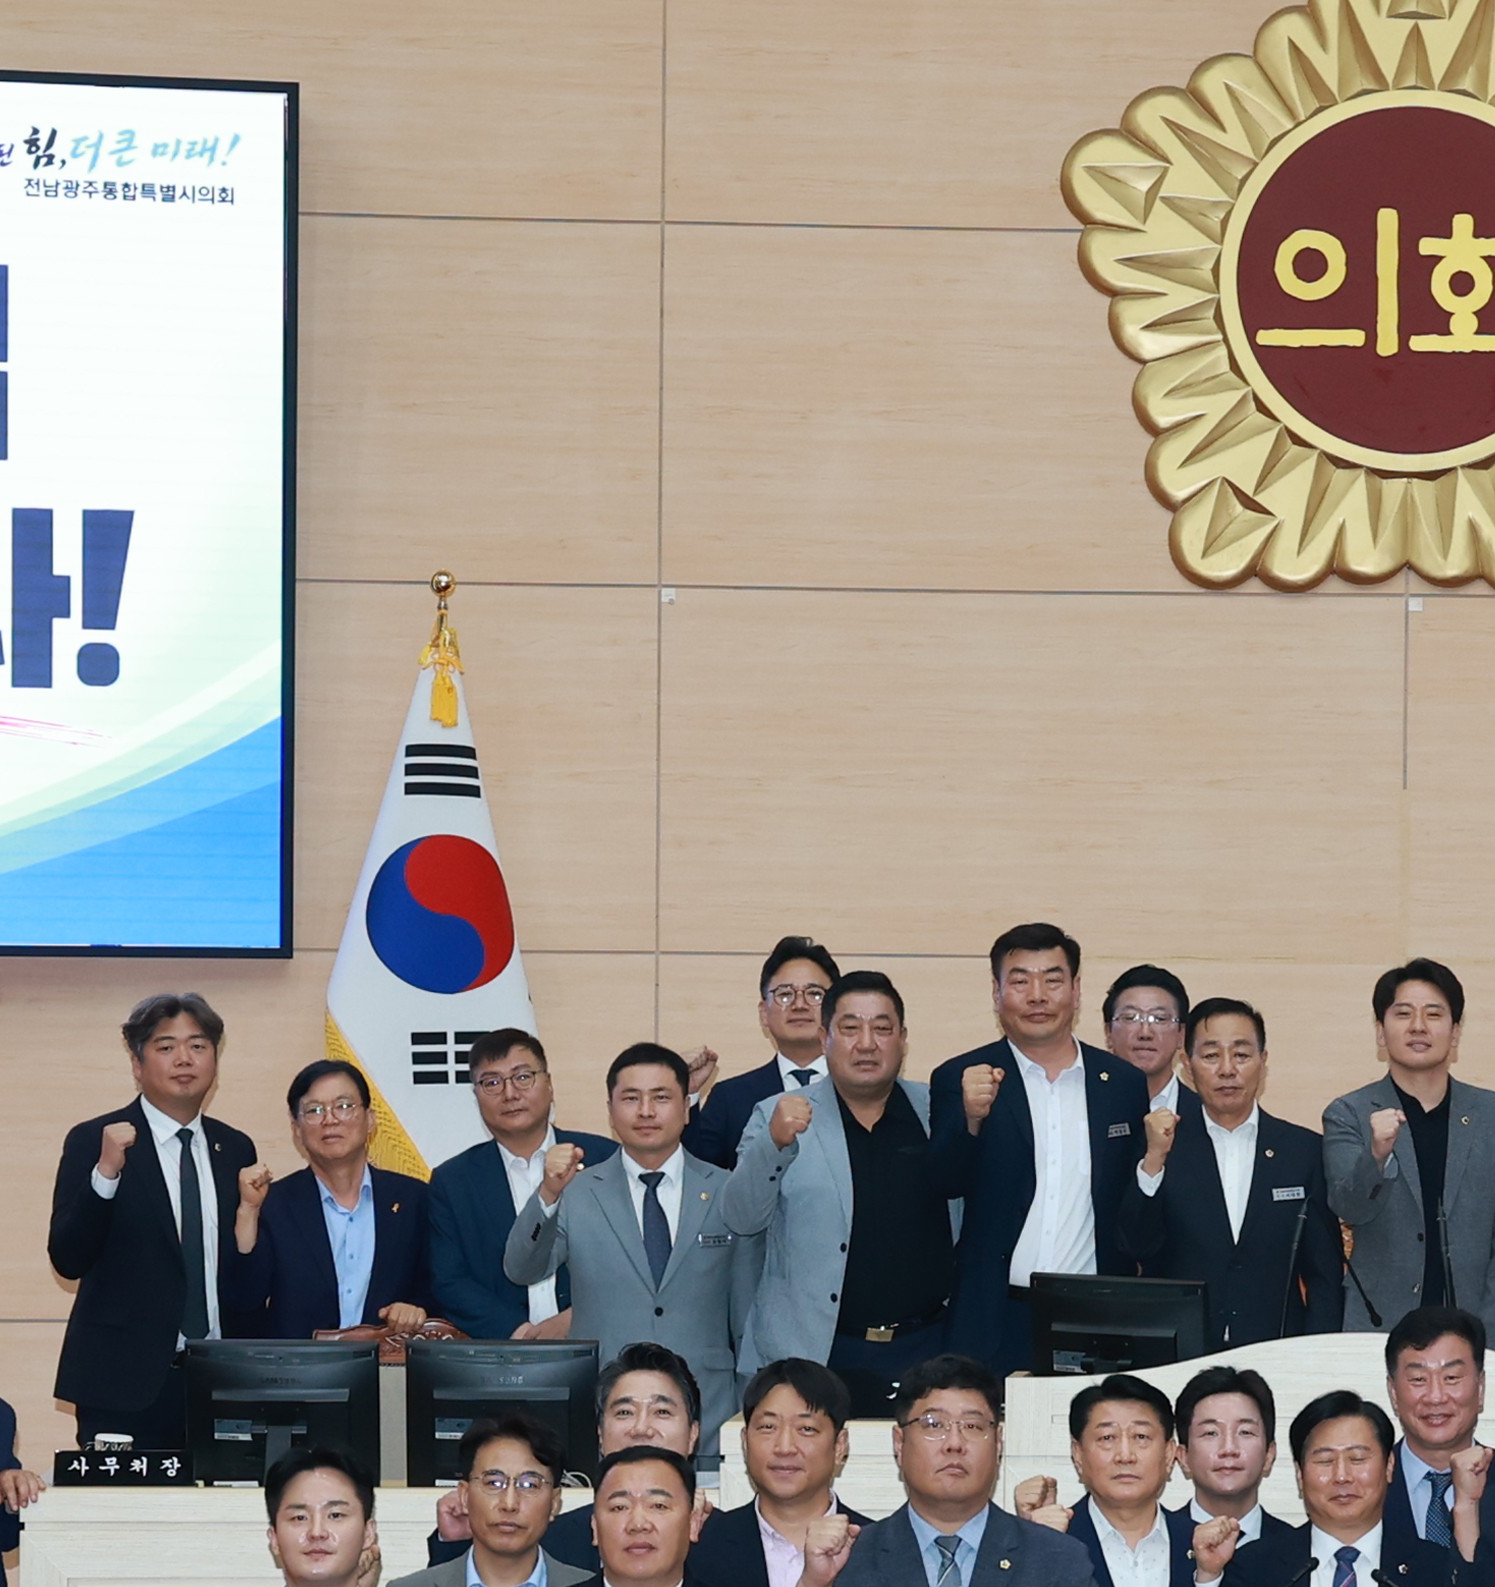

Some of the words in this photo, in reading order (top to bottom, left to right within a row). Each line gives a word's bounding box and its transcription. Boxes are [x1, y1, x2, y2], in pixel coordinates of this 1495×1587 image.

[69, 130, 104, 174] 더
[108, 129, 139, 169] 큰
[150, 132, 243, 168] 미래!
[23, 178, 235, 206] 전남광주통합특별시의회
[67, 1456, 182, 1477] 사무처장
